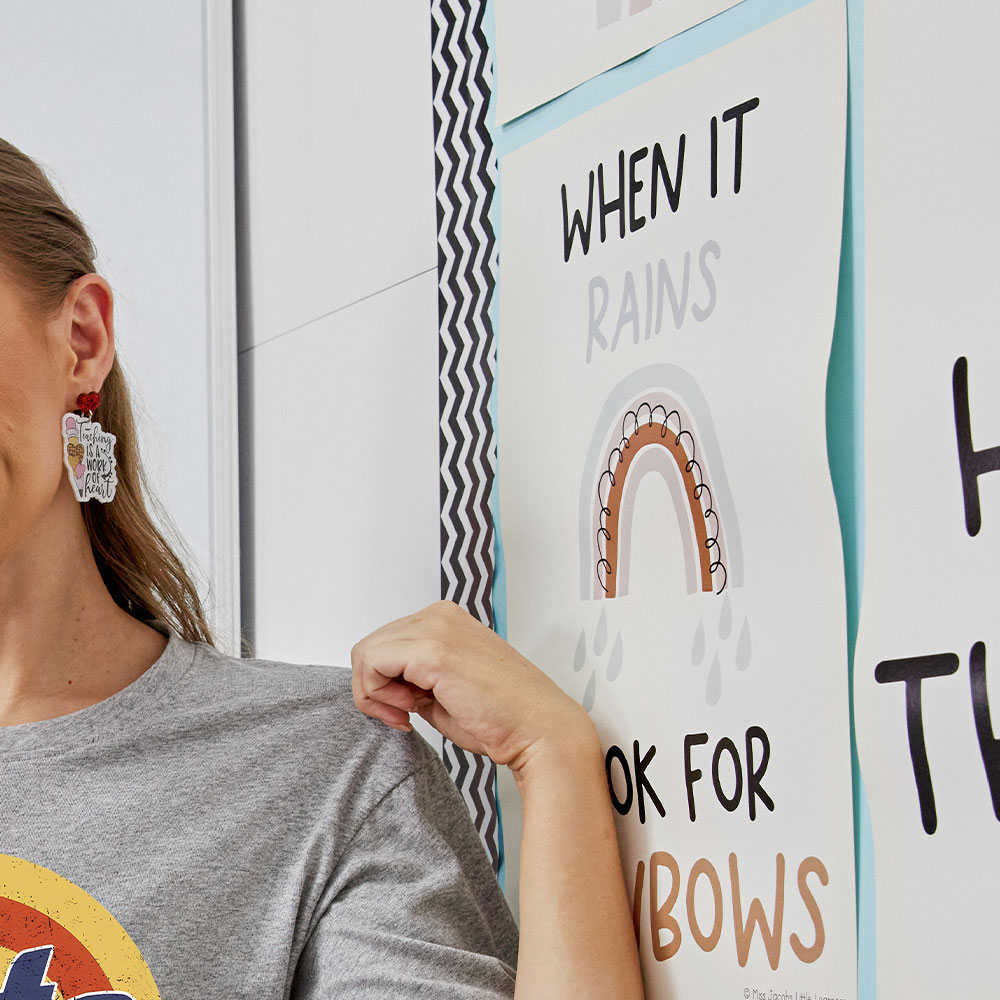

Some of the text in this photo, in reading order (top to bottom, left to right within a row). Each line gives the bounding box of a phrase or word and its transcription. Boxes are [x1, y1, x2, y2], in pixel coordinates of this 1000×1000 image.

[561, 98, 759, 262] WHEN IT
[586, 240, 721, 363] RAINS
[76, 419, 112, 453] Teaching
[87, 443, 100, 458] IS A
[87, 458, 106, 472] WORK
[85, 473, 114, 498] heart
[92, 472, 100, 484] OF
[684, 726, 774, 822] FOR
[752, 988, 766, 1000] Miss
